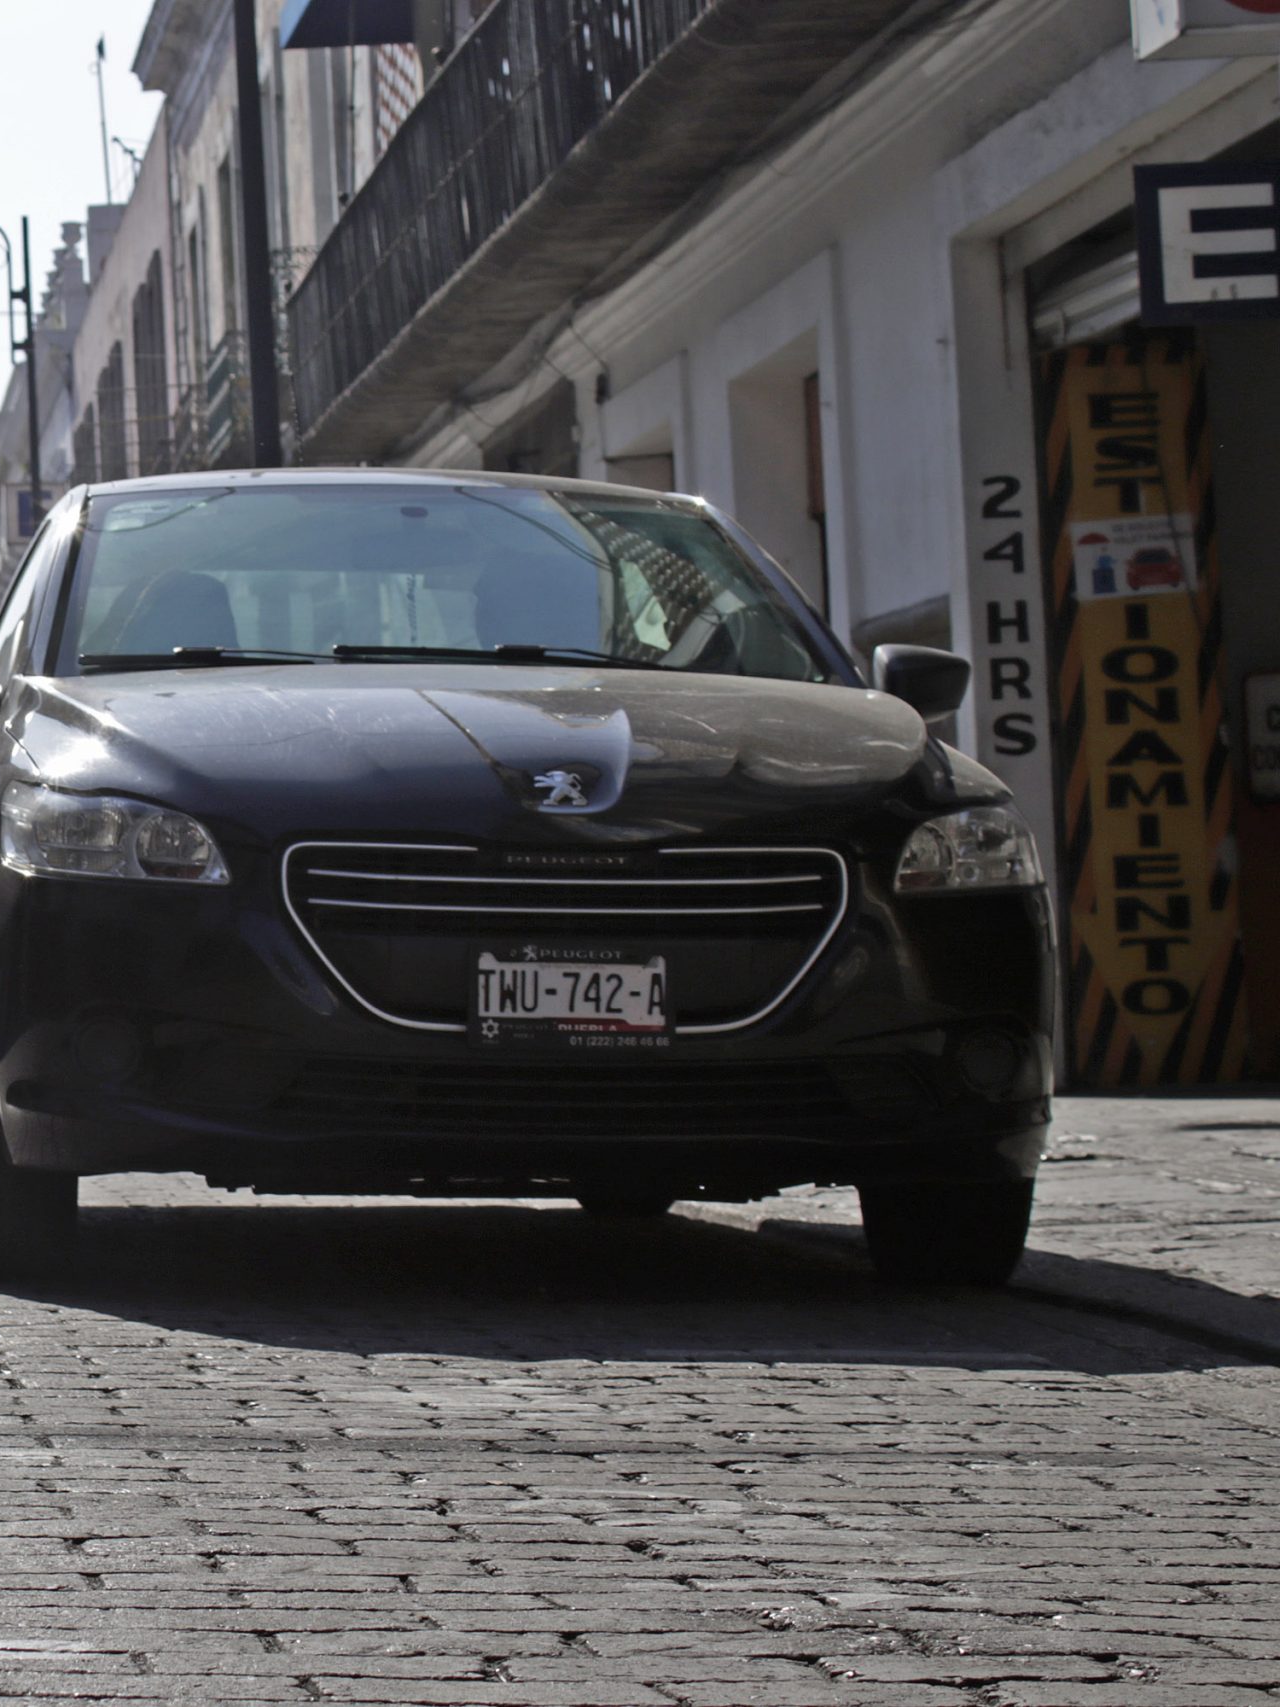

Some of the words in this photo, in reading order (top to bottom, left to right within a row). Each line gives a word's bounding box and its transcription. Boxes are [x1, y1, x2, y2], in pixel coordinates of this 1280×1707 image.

[1157, 183, 1279, 305] E
[980, 475, 1025, 575] 24
[986, 601, 1037, 757] HRS
[1088, 391, 1192, 1017] ESTIONAMIENTO
[477, 969, 666, 1016] TWU-742-A
[539, 948, 624, 960] PEUGEOT
